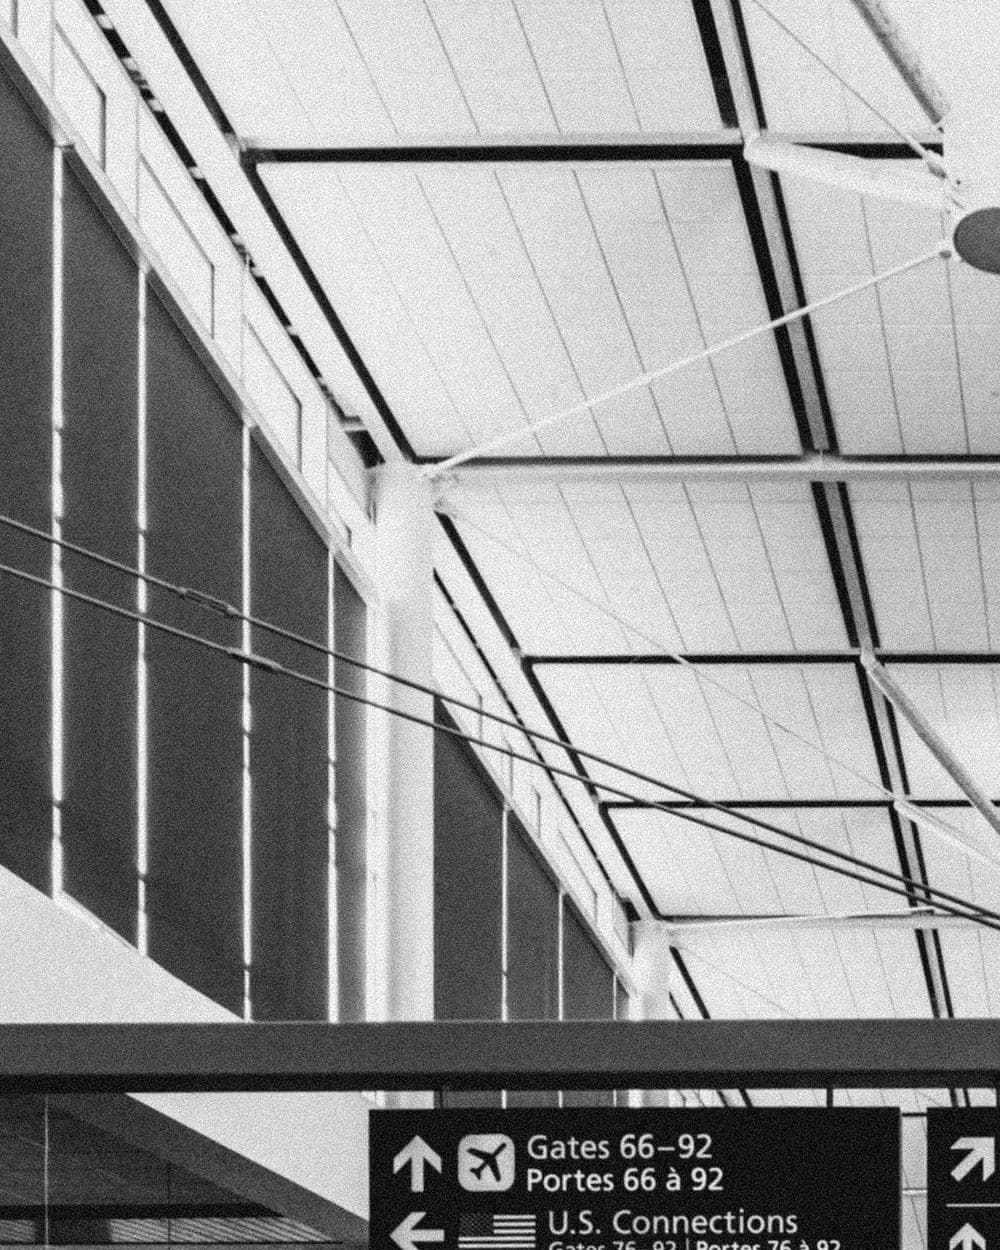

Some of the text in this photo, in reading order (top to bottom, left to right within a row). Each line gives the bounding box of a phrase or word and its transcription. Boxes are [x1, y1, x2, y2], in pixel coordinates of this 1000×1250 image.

[527, 1133, 713, 1160] Gates 66–92
[526, 1166, 724, 1193] Portes 66 à 92
[548, 1207, 798, 1236] U.S. Connections
